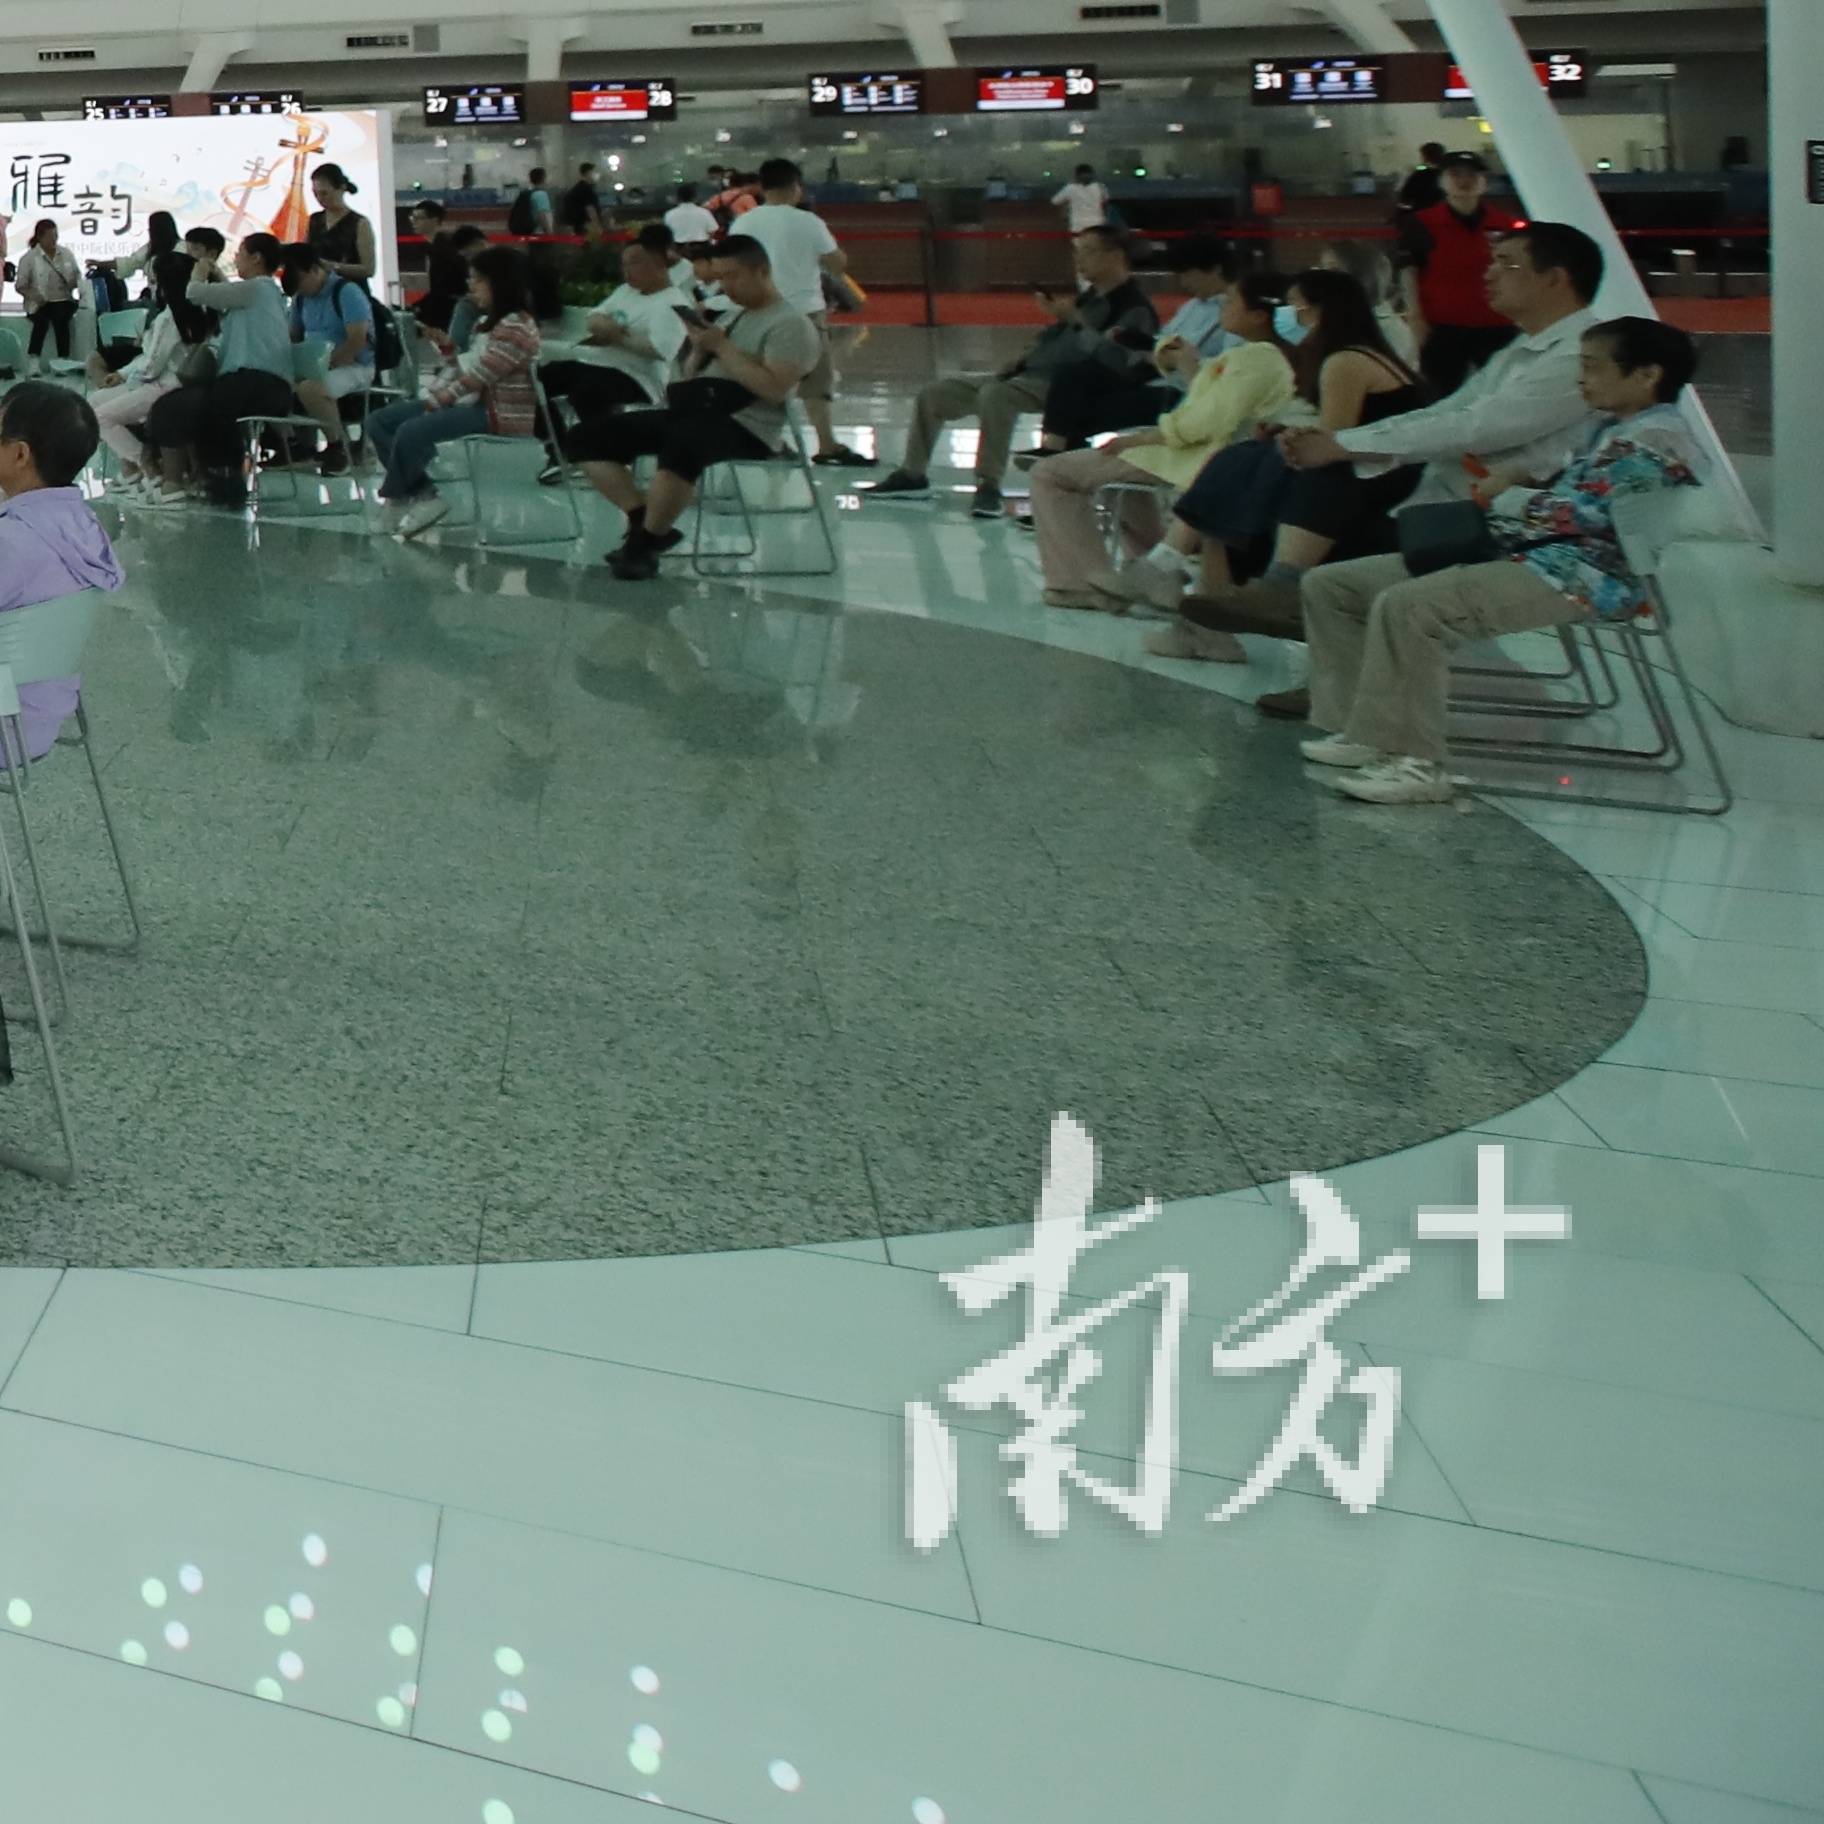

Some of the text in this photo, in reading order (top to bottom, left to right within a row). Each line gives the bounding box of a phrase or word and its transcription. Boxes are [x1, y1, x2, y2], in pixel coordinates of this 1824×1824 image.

[1548, 64, 1582, 81] 32
[1065, 77, 1094, 95] 30
[1254, 73, 1283, 90] 31
[648, 90, 673, 107] 28
[811, 85, 838, 103] 29
[426, 97, 449, 113] 27
[86, 108, 105, 121] 25
